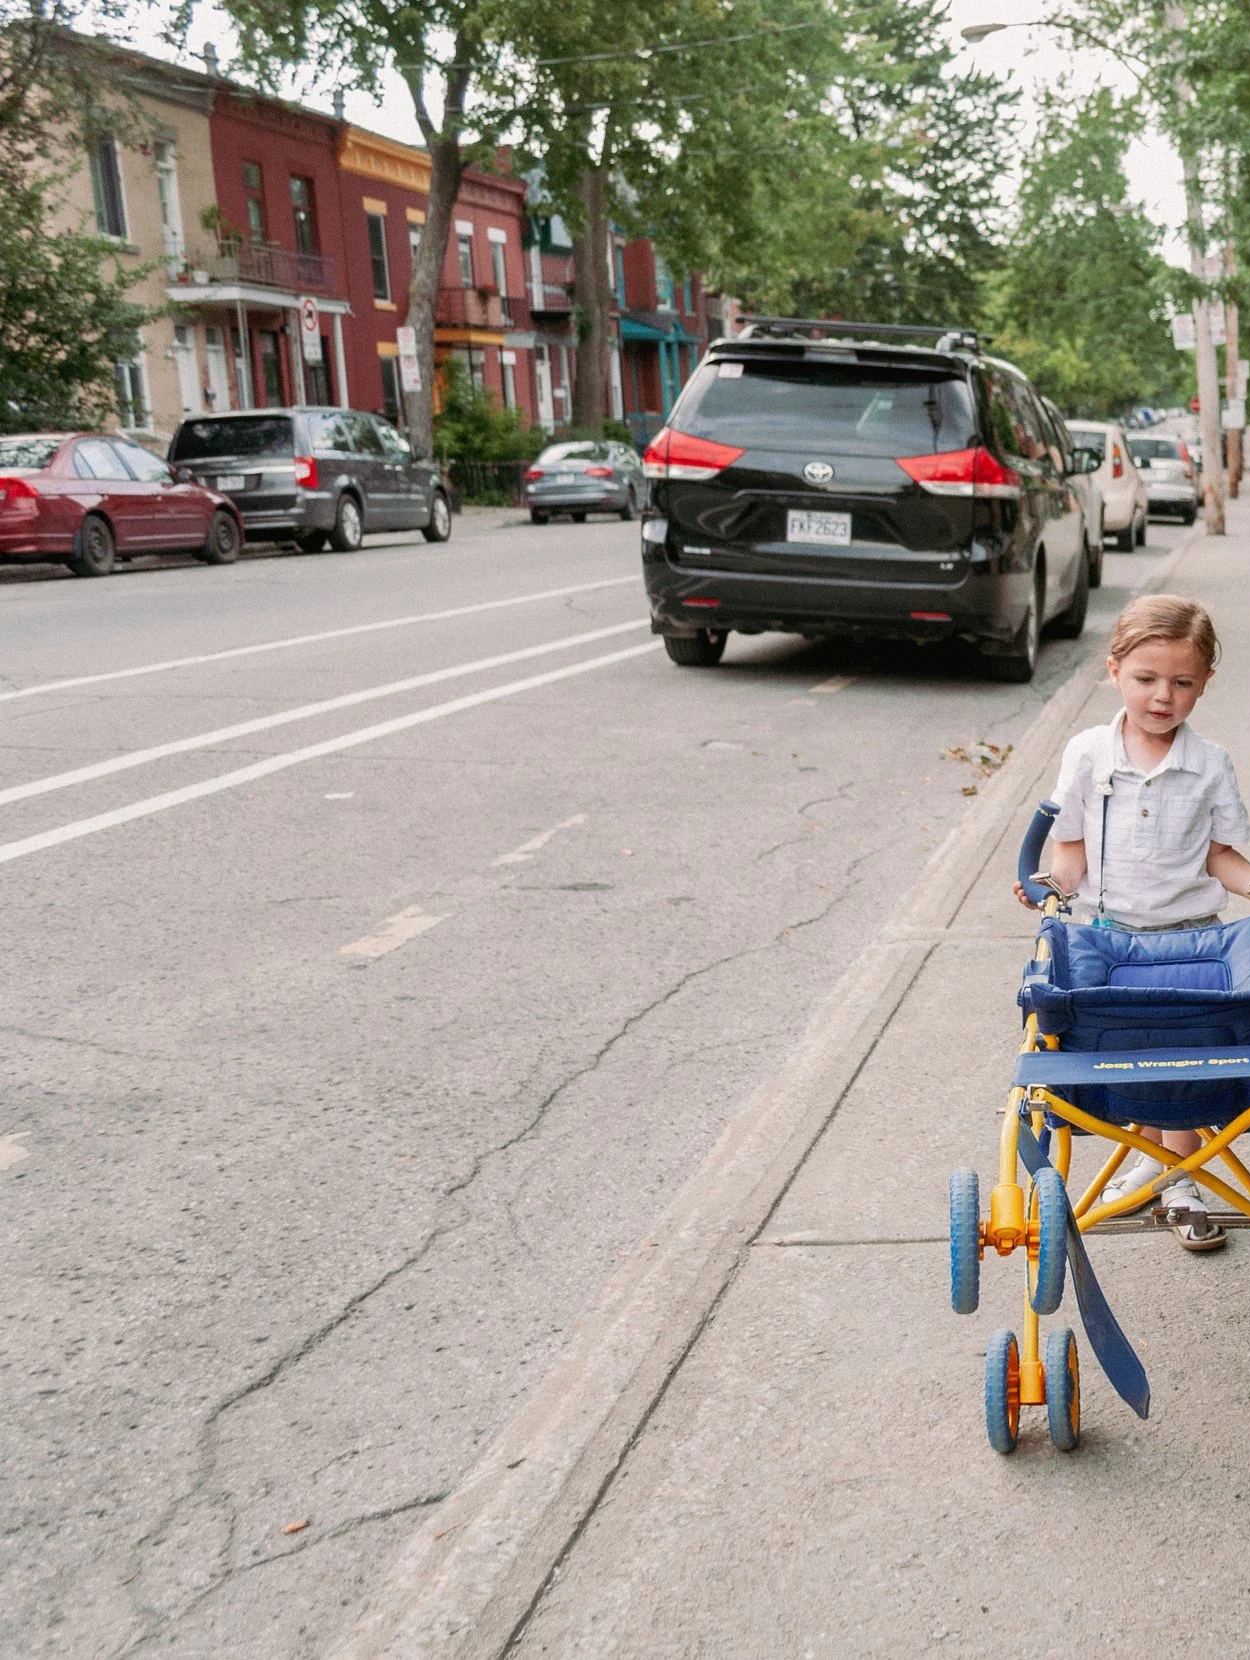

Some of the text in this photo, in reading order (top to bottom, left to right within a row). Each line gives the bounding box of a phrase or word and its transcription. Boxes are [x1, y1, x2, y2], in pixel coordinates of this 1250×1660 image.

[1093, 1056, 1250, 1070] Jeep Wrangler Sport
